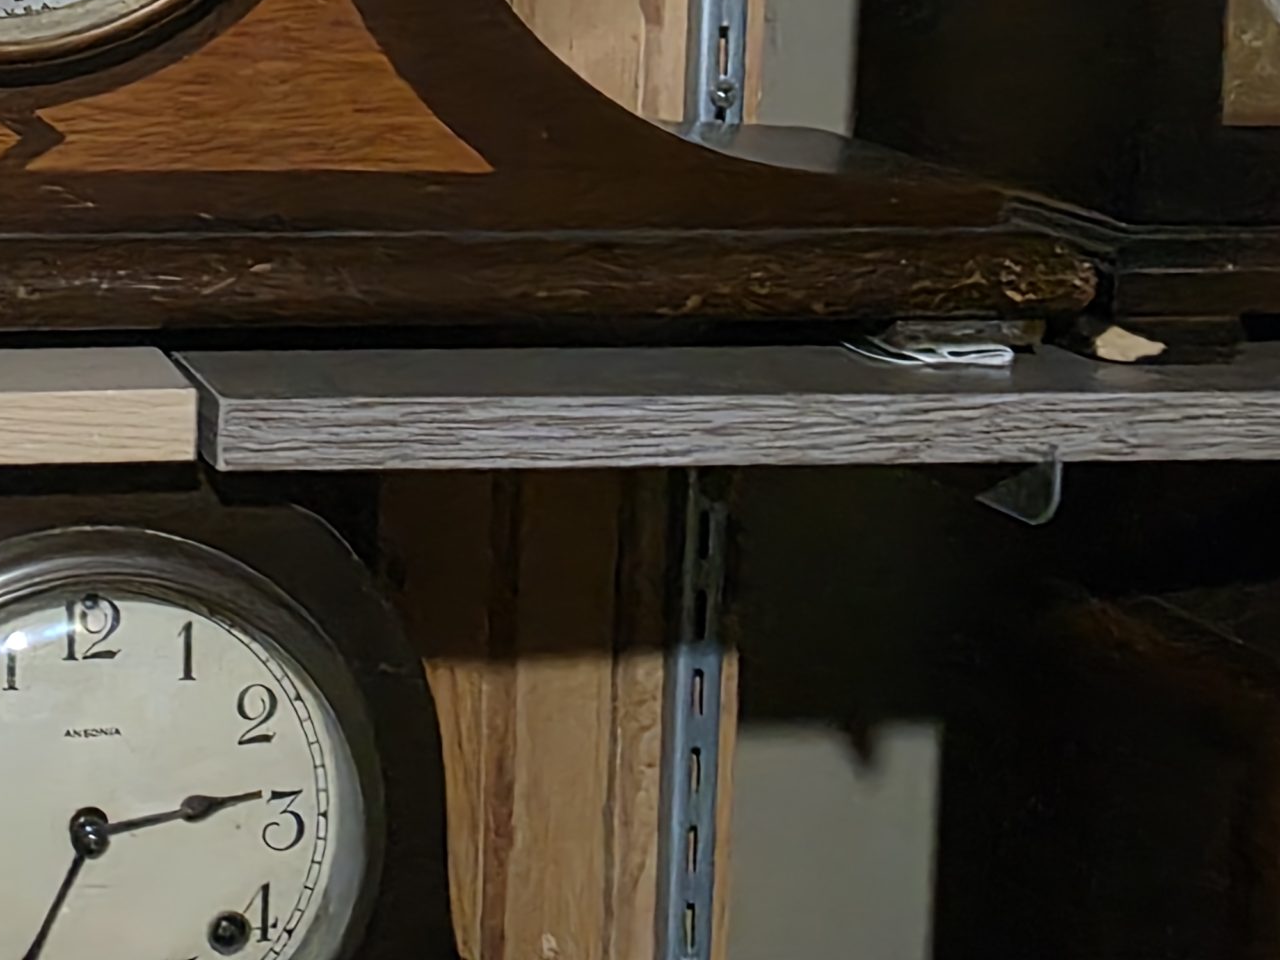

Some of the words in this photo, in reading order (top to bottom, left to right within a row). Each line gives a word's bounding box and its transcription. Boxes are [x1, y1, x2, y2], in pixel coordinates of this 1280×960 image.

[62, 593, 122, 661] 12
[177, 621, 196, 681] 1
[236, 683, 278, 745] 2
[262, 789, 305, 851] 3
[239, 882, 278, 942] 4
